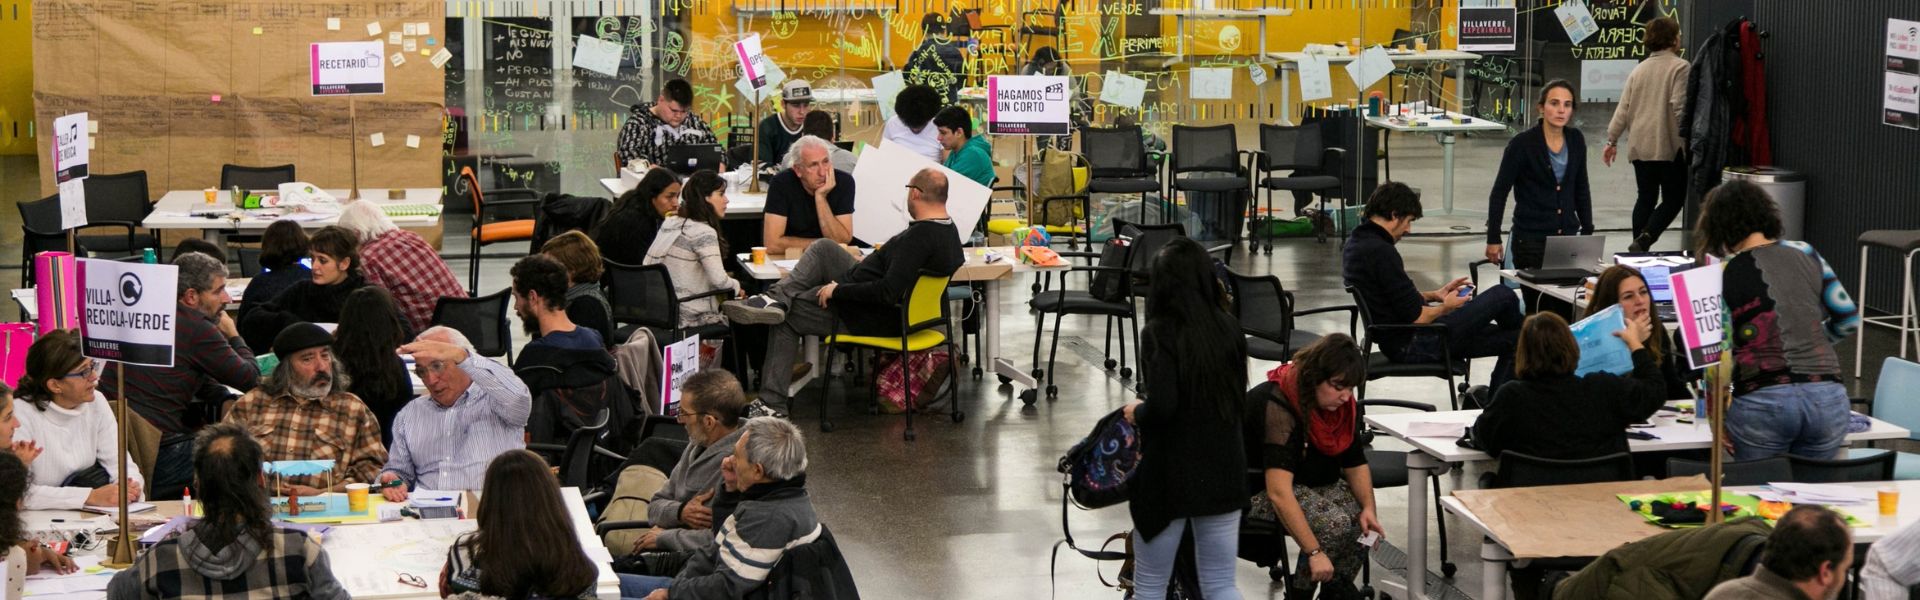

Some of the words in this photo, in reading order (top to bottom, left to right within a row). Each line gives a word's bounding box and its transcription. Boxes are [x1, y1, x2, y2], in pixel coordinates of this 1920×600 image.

[1463, 20, 1506, 28] VILLAVERDE
[970, 30, 1007, 42] WIFI
[506, 50, 523, 61] NO
[968, 43, 1015, 58] GRATIS
[320, 59, 366, 69] RECETARIO
[508, 65, 539, 75] PERO
[962, 57, 1008, 76] MEDIA
[998, 89, 1043, 101] HAGAMOS
[998, 101, 1010, 112] UN
[1013, 101, 1045, 113] CORTO
[86, 288, 116, 306] VILLA-
[87, 308, 170, 330] RECICLA-VERDE
[89, 340, 120, 350] VILLAVERDE
